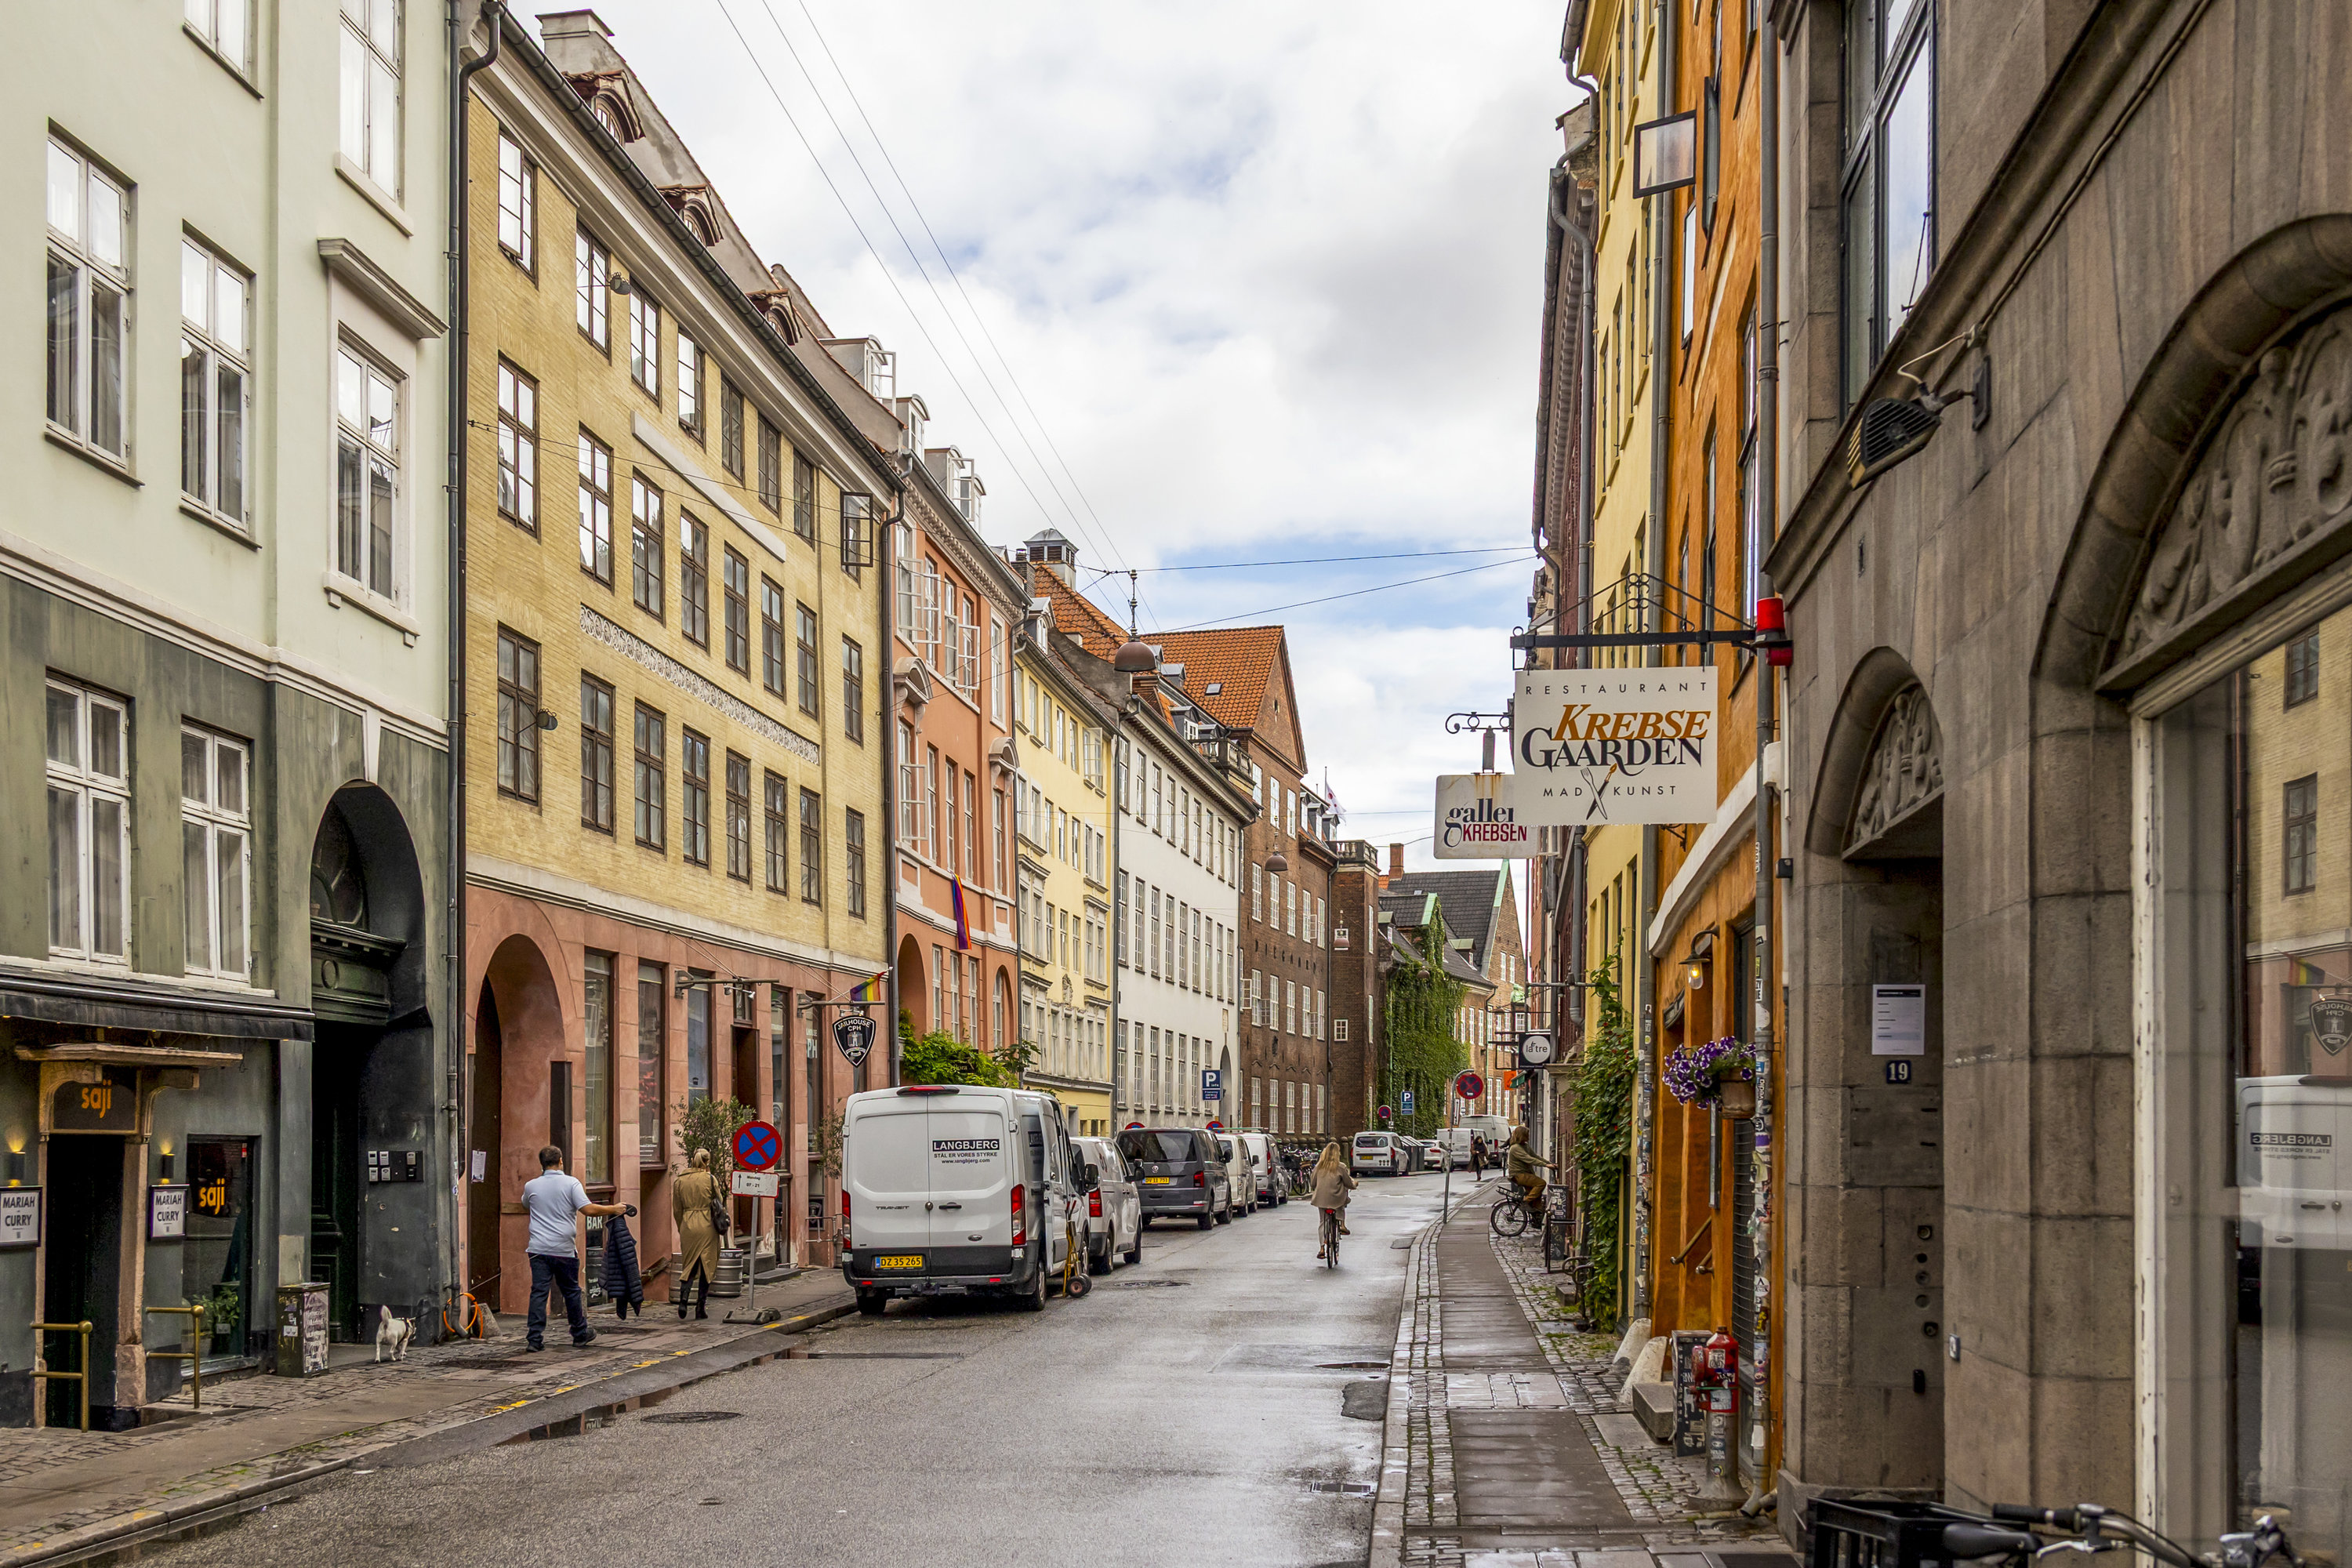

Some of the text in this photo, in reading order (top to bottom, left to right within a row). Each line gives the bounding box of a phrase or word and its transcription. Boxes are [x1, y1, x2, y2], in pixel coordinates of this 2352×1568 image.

[1526, 681, 1707, 695] RESTAURANT
[1551, 704, 1711, 741] KREBSE
[1521, 728, 1704, 776] GAARDEN
[1543, 786, 1677, 797] MAD KUNST
[1462, 823, 1527, 842] KREBSEN
[837, 1018, 872, 1030] JAILHOUSE
[808, 1039, 818, 1058] PH
[1889, 1062, 1908, 1080] 19
[1206, 1072, 1217, 1087] P
[82, 1079, 112, 1119] saji
[1403, 1092, 1411, 1102] P
[934, 1141, 999, 1150] LANGBJERG
[3, 1196, 35, 1208] MARIAH
[155, 1194, 183, 1206] MARIAH
[198, 1178, 226, 1215] saji
[5, 1214, 32, 1227] CURRY
[157, 1210, 180, 1222] CURRY
[906, 1257, 921, 1265] 265
